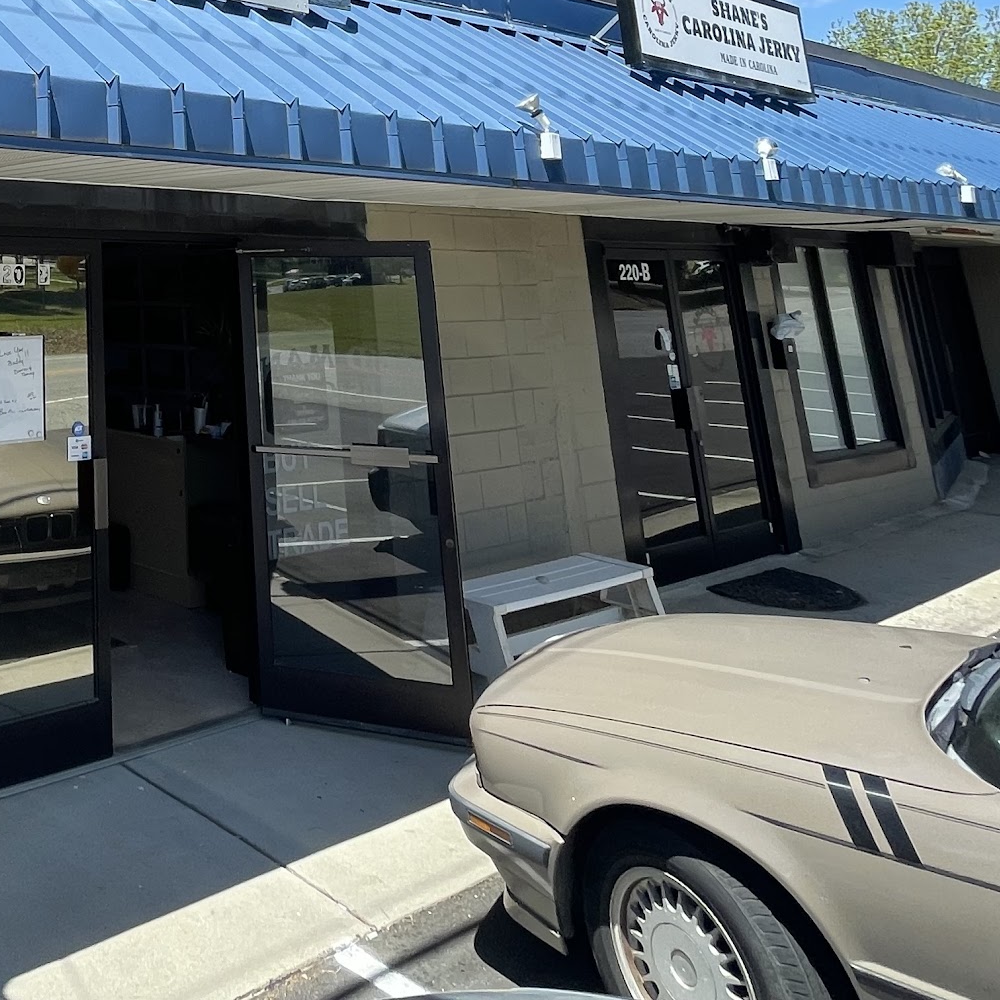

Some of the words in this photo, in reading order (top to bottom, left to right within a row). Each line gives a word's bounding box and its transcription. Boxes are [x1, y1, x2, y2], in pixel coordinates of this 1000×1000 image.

[682, 15, 756, 52] CAROLINA
[759, 36, 801, 63] JERKY
[719, 52, 739, 67] MADE
[739, 58, 748, 68] IN
[749, 59, 779, 76] CAROLINA
[618, 262, 651, 282] 220-B
